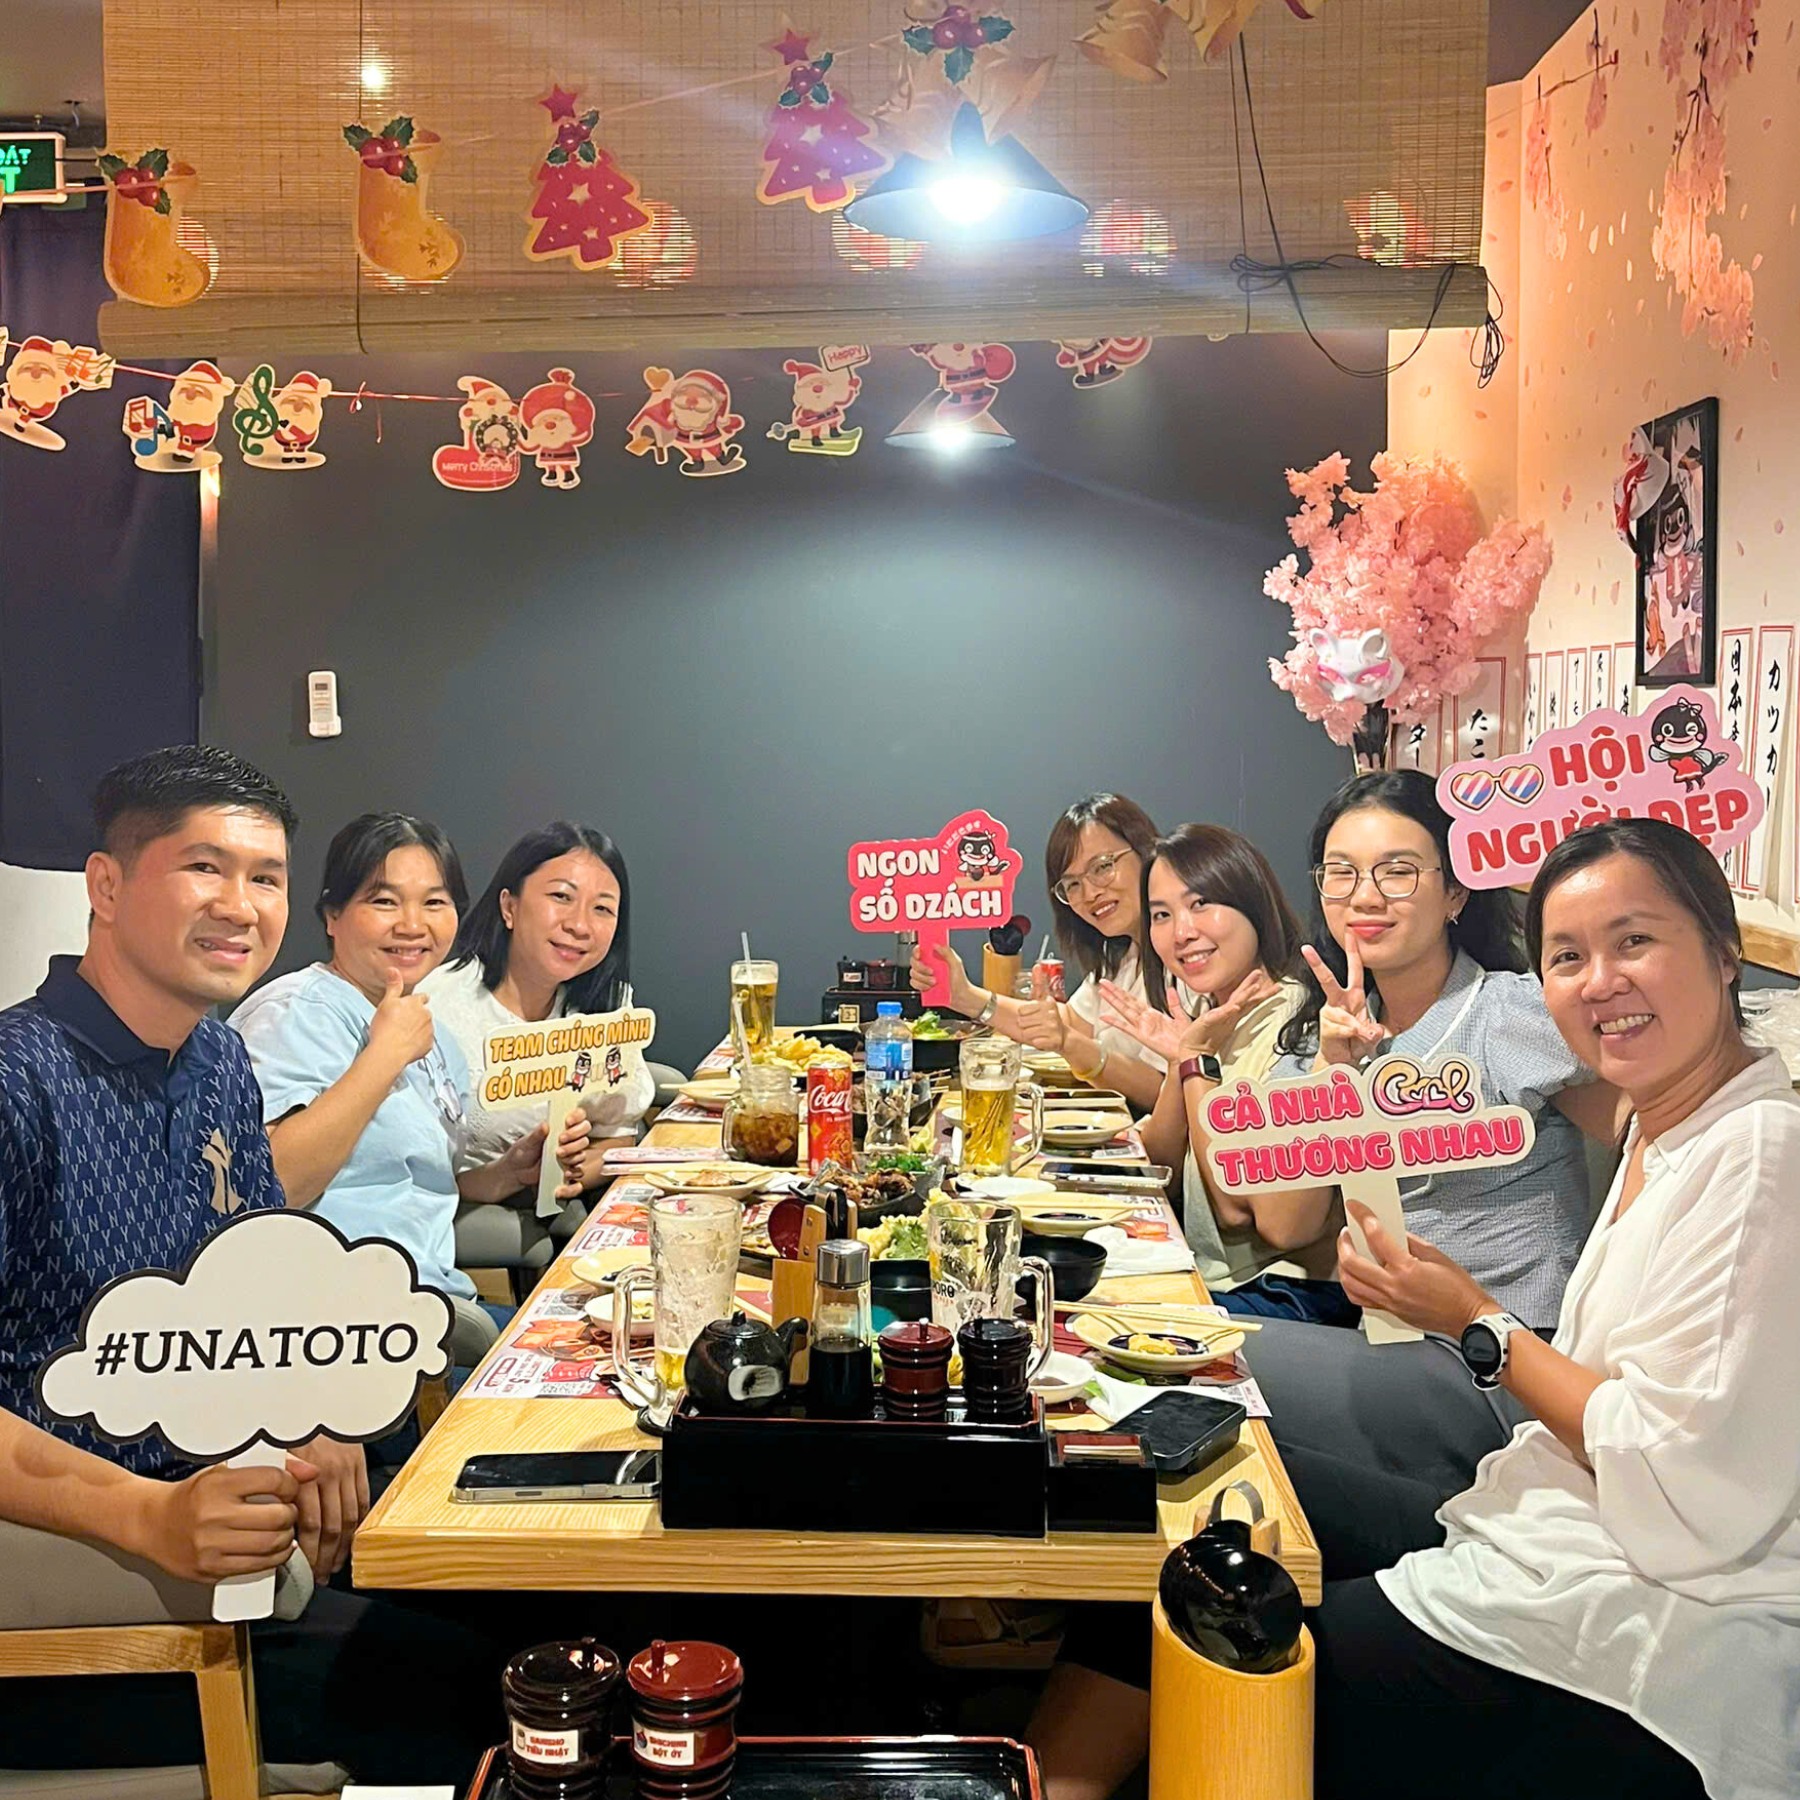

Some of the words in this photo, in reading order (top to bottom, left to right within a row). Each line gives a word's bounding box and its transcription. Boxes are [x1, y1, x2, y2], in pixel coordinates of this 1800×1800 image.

[1550, 726, 1647, 792] HỘI
[856, 848, 940, 878] NGON
[859, 878, 899, 923] SỐ
[905, 882, 1002, 920] DZÁCH
[490, 1032, 545, 1063] TEAM
[546, 1020, 605, 1055] CHÚNG
[606, 1013, 651, 1046] MÌNH
[486, 1066, 513, 1102] CÓ
[515, 1065, 568, 1098] NHAU
[1208, 1082, 1265, 1132] CẢ
[1270, 1071, 1363, 1126] NHÀ
[1216, 1132, 1394, 1186] THƯƠNG
[1400, 1116, 1525, 1165] NHAU
[95, 1323, 418, 1375] #UNATOTO
